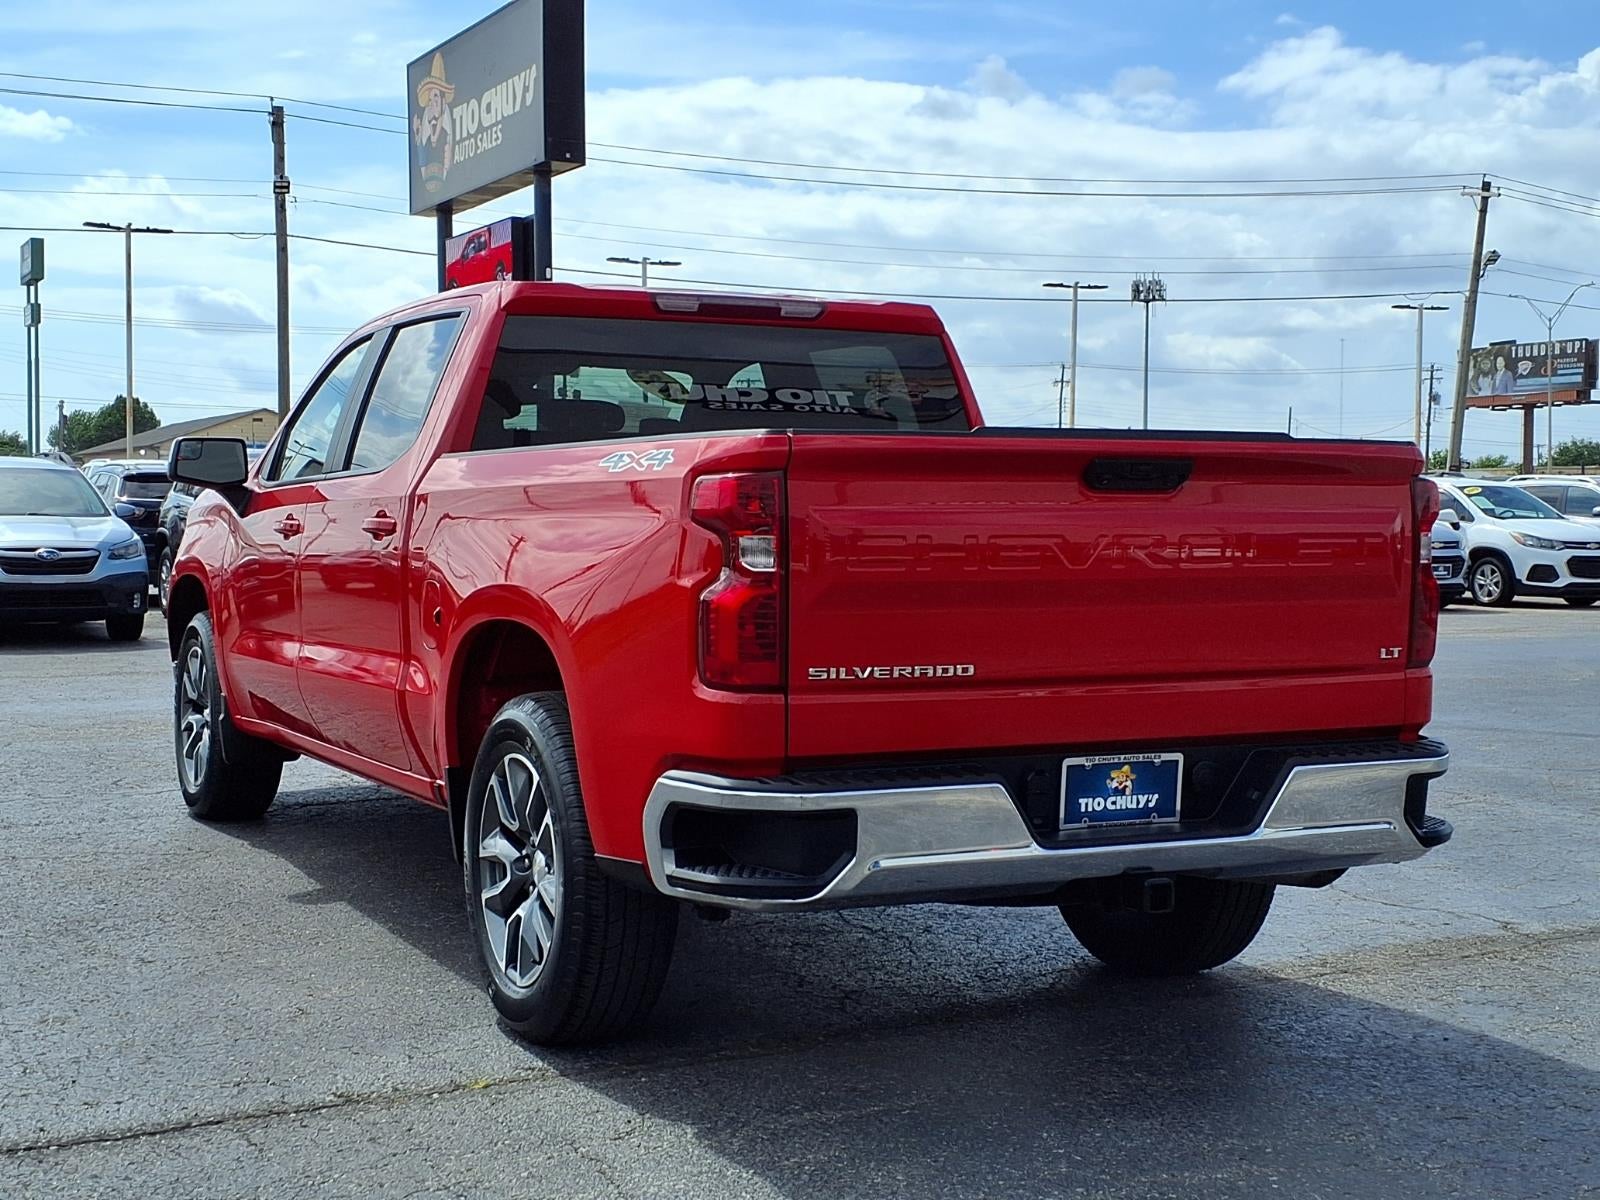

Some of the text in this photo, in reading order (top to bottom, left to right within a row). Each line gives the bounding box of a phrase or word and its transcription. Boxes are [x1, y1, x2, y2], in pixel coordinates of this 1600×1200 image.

[453, 63, 537, 141] TIO CHUY'S
[453, 123, 502, 165] AUTO SALES
[1380, 647, 1403, 659] LT
[808, 664, 975, 680] SILVERADO
[1078, 793, 1159, 812] TIO CHUY'S
